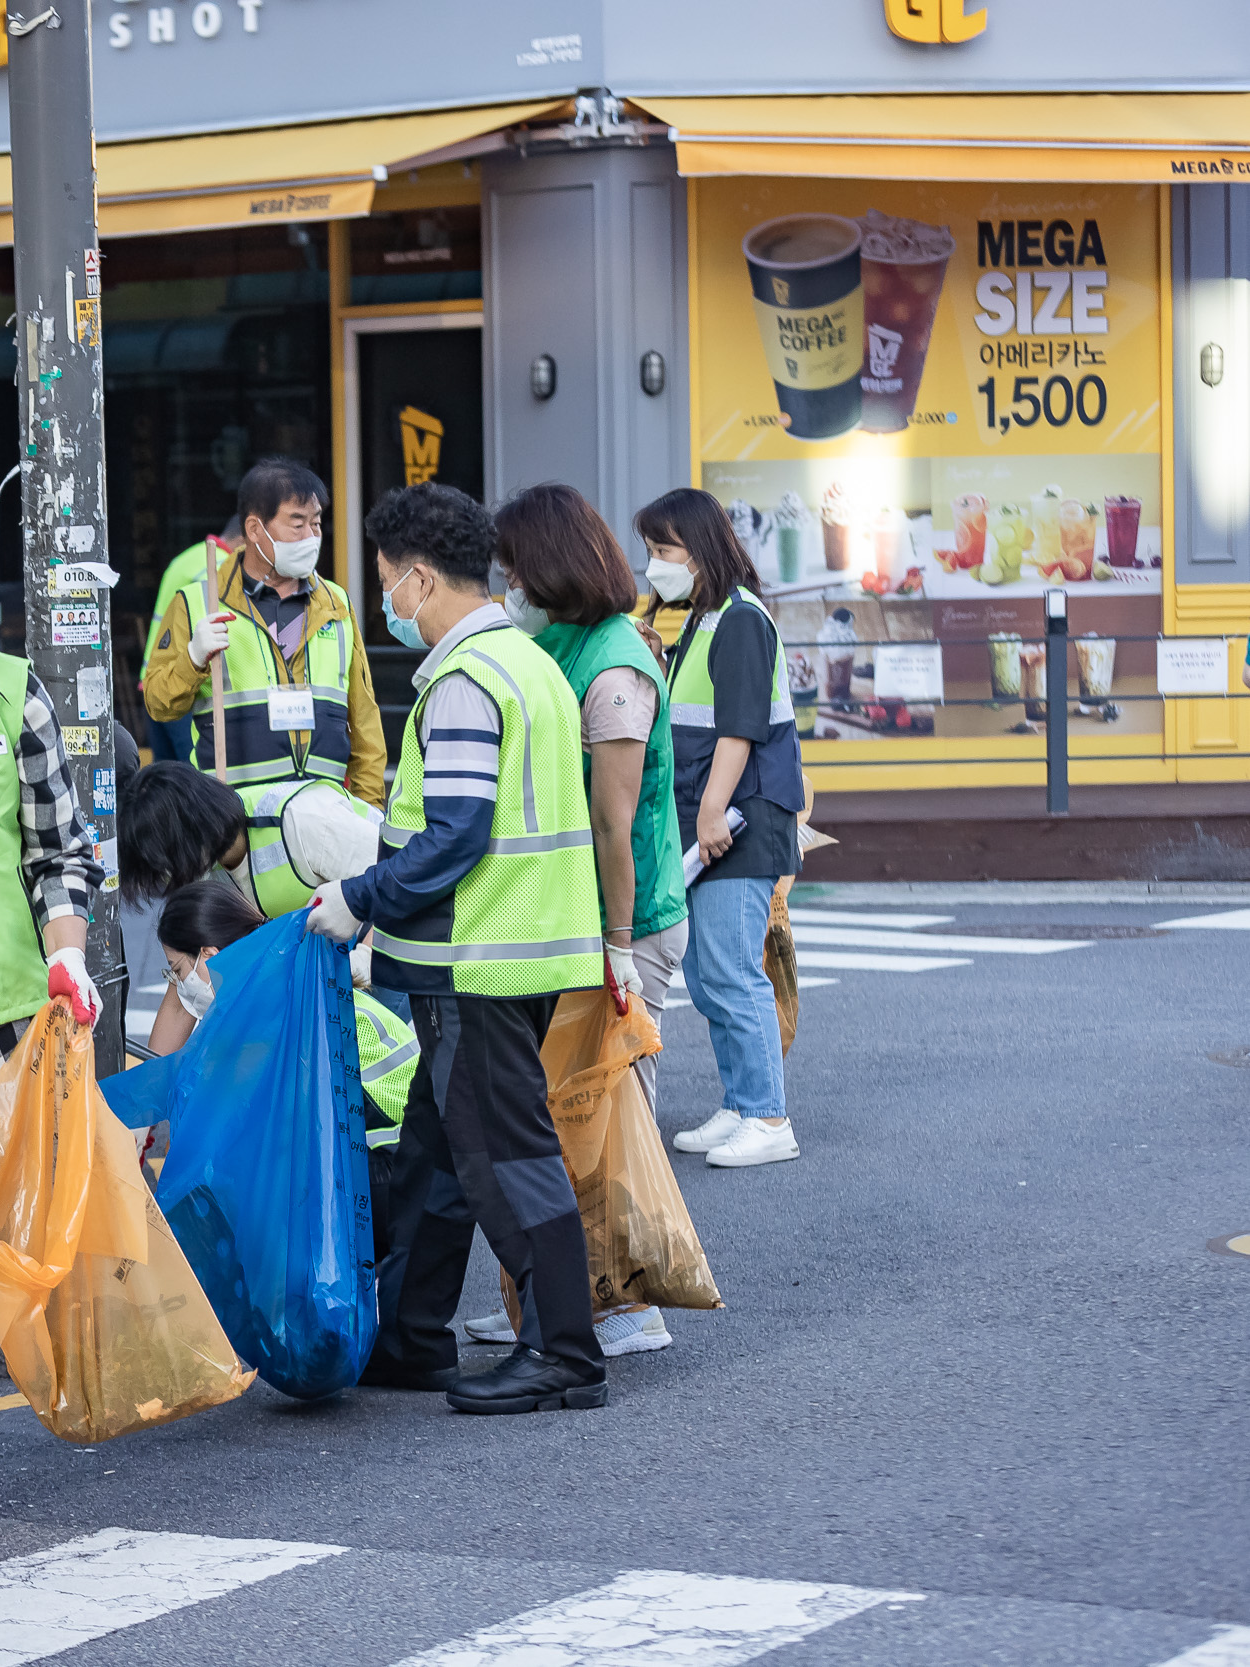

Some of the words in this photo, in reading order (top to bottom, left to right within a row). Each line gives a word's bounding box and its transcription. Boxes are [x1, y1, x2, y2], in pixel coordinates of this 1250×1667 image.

[108, 0, 263, 48] SHOT
[1171, 160, 1221, 174] MEGA
[977, 219, 1107, 267] MEGA
[974, 271, 1108, 336] SIZE
[777, 314, 834, 333] MEGA
[779, 325, 847, 352] COFFEE
[979, 341, 1107, 369] 아메리카노
[977, 374, 1108, 434] 1,500
